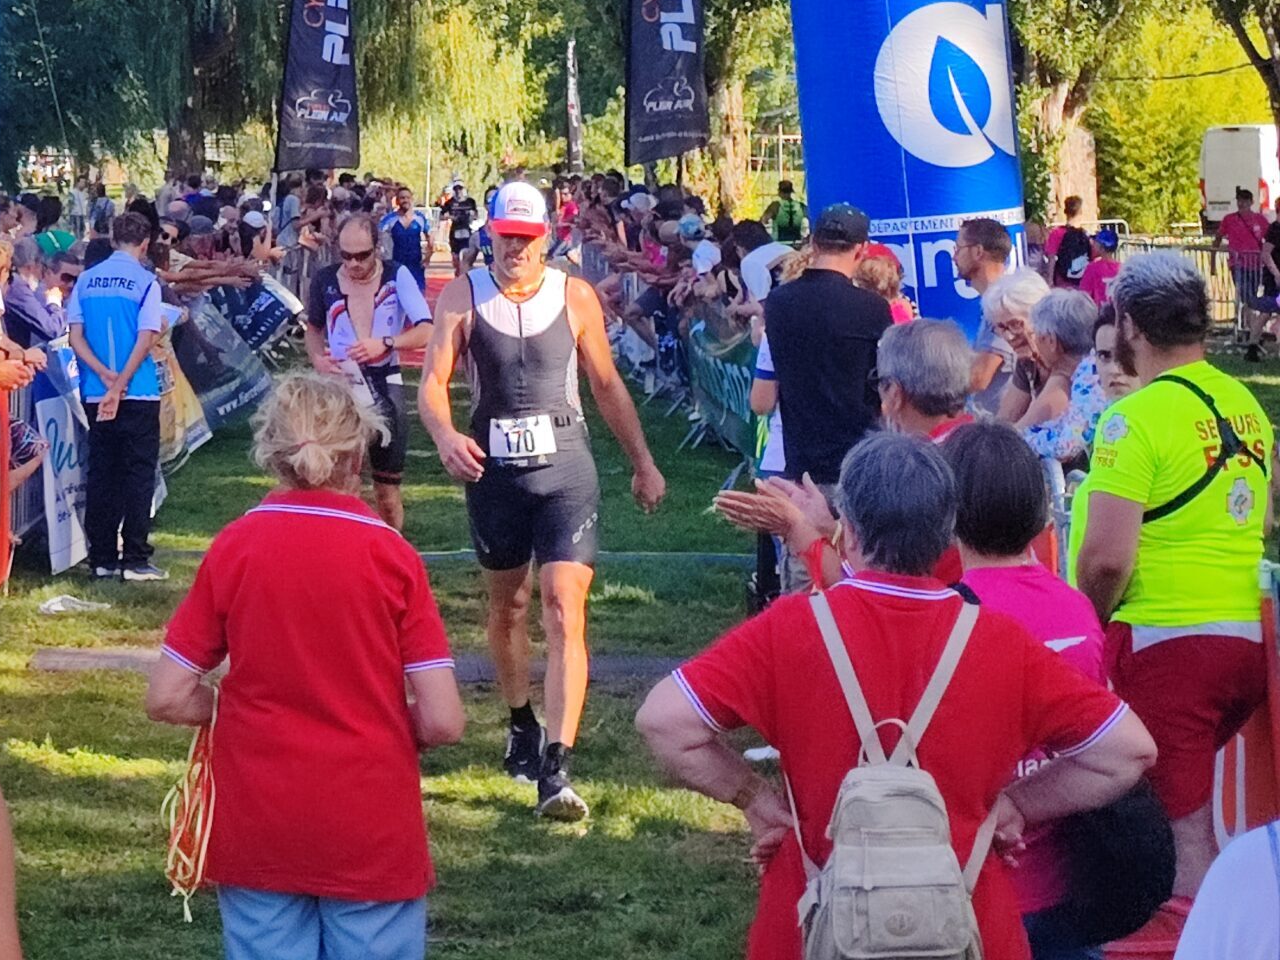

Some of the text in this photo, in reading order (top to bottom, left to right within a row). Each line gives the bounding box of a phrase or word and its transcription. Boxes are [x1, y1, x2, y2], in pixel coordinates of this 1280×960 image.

[86, 276, 136, 291] ARBITRE
[1195, 413, 1262, 441] SEURS
[504, 429, 535, 453] 170
